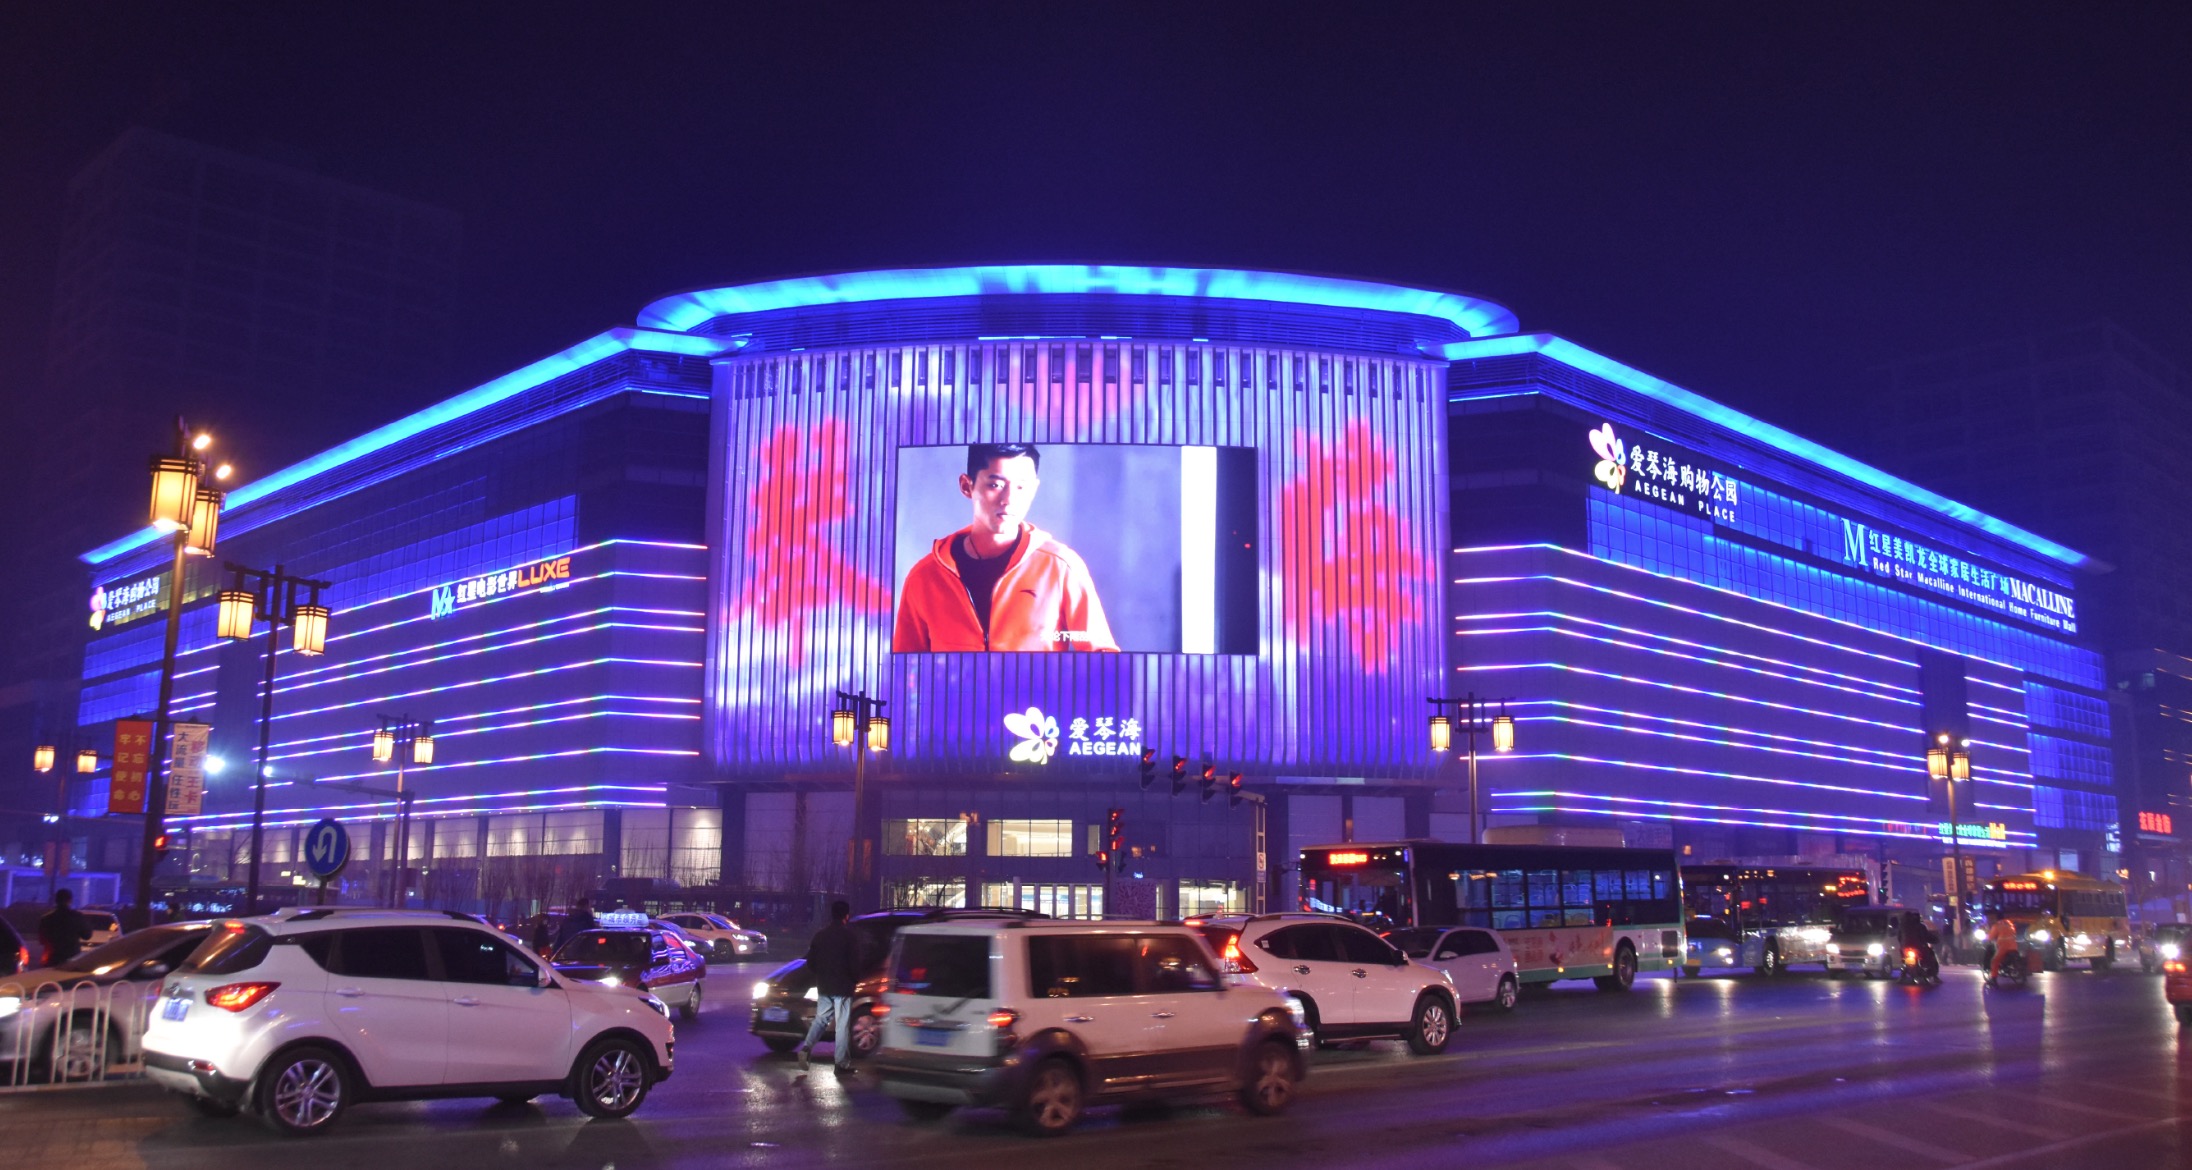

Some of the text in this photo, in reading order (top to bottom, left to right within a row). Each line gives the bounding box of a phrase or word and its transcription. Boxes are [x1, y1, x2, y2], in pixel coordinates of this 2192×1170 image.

[1630, 445, 1737, 506] 爱琴海购物公园
[1634, 480, 1735, 522] AEGEAN PLACE
[457, 570, 518, 603] 红星电影世界
[518, 557, 571, 588] LUXE
[1869, 530, 2075, 619] 红星美凯龙全球家居生活广场 MACALLINE
[1873, 557, 2077, 633] Red Star Macalline International Home Furniture Mall
[1069, 717, 1141, 741] 爱琴海
[1069, 741, 1141, 755] AEGEAN
